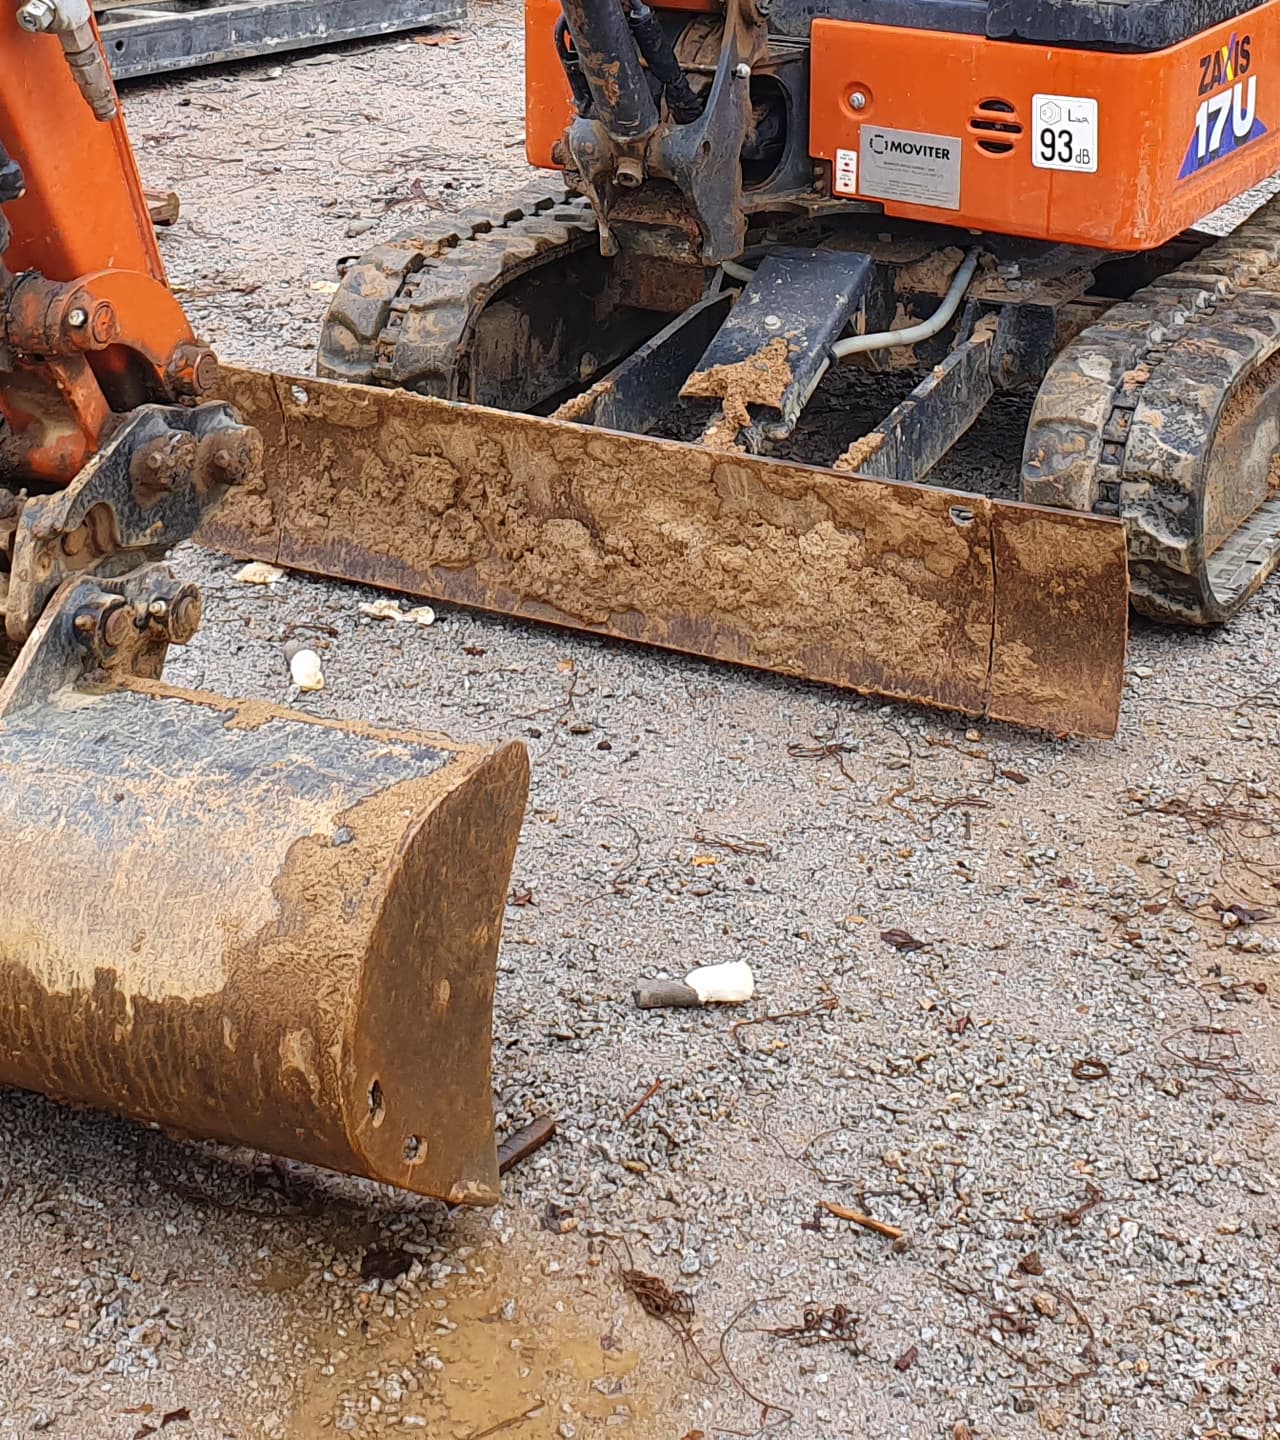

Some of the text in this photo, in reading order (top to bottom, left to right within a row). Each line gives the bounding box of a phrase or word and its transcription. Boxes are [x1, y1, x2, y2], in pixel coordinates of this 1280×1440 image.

[1197, 32, 1252, 97] ZAXIS
[1194, 75, 1258, 160] 17U
[889, 140, 951, 161] MOVITER
[1040, 127, 1091, 165] 93 dB
